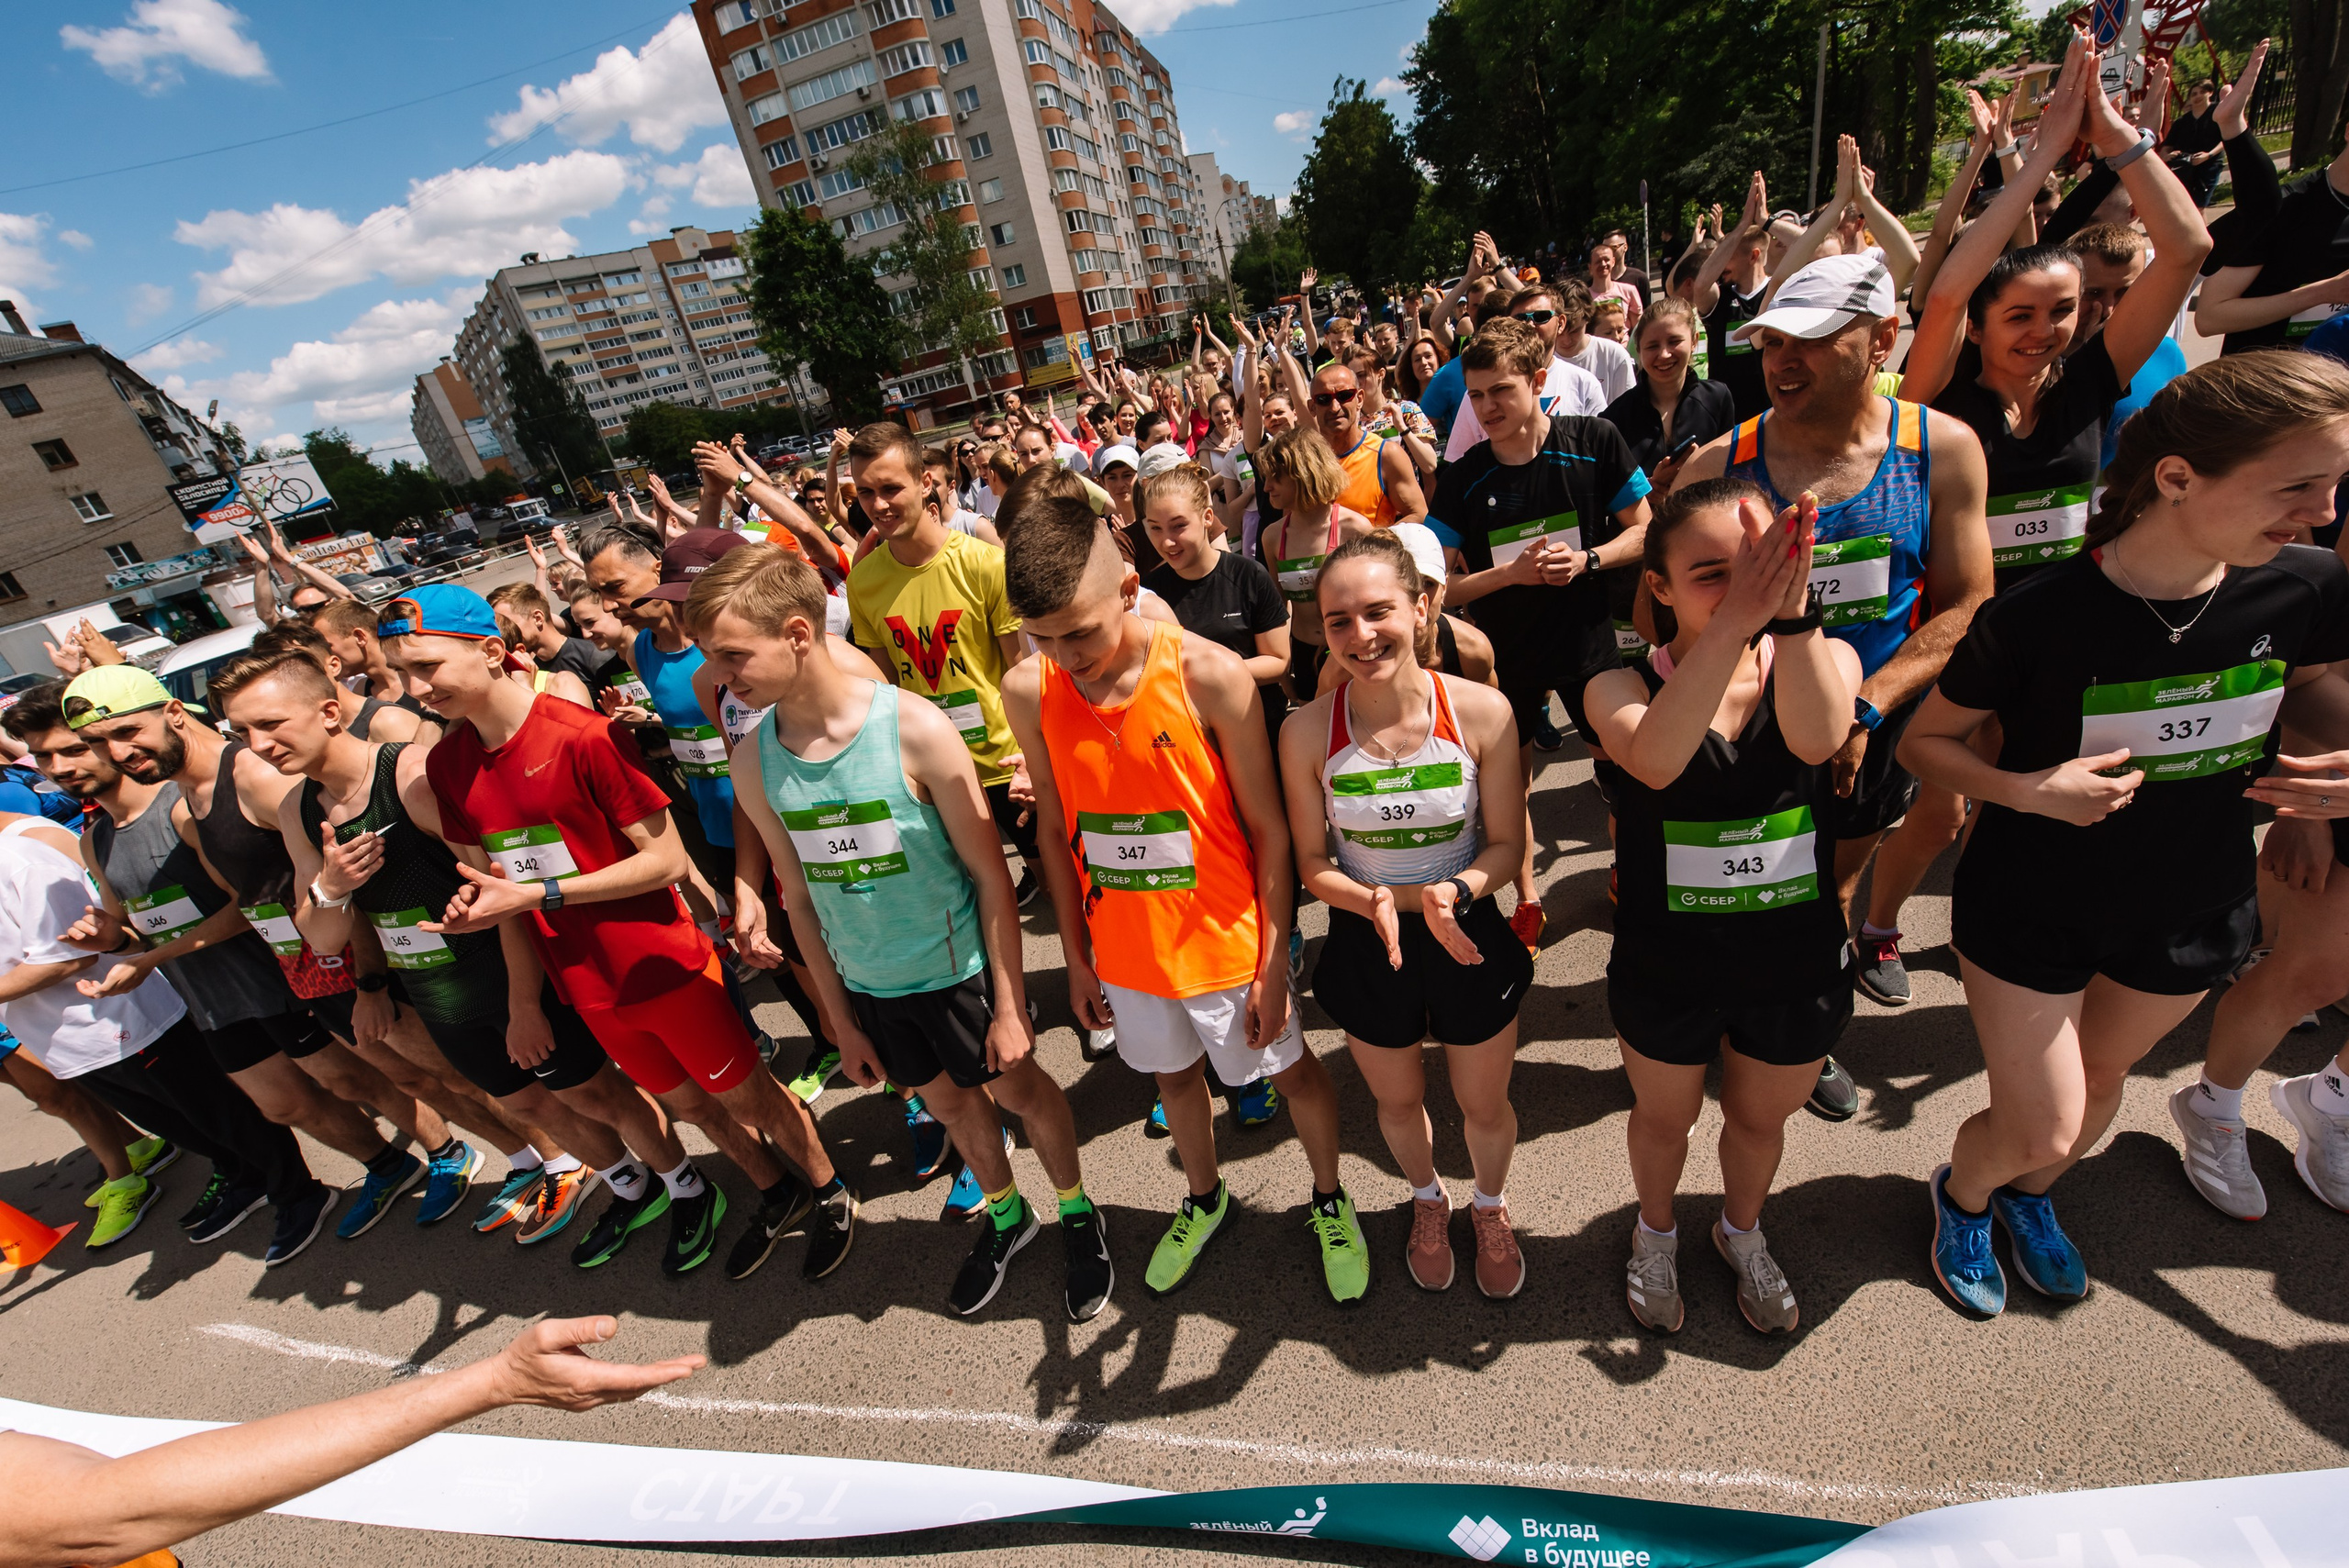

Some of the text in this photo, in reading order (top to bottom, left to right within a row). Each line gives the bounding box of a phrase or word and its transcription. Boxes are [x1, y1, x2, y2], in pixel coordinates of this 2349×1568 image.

[174, 477, 229, 495] СКОРОСТНОЙ
[2014, 520, 2048, 537] 033
[1993, 552, 2023, 562] СБЕР
[892, 624, 958, 649] ONE
[901, 656, 967, 682] RUN
[2157, 685, 2194, 695] ЗЕЛЁНЫЙ
[2154, 695, 2195, 704] МАРАФОН
[2157, 717, 2211, 742] 337
[689, 749, 706, 759] 028
[1380, 804, 1415, 821] 339
[828, 838, 858, 854] 344
[1118, 846, 1146, 860] 347
[515, 858, 540, 873] 342
[1722, 856, 1765, 876] 343
[1108, 874, 1130, 884] СБЕР
[1699, 895, 1736, 906] СБЕР
[148, 916, 167, 928] 346
[390, 936, 411, 947] 345
[1189, 1520, 1275, 1531] ЗЕЛЁНЫЙ
[1521, 1518, 1599, 1542] Вклад
[1524, 1541, 1652, 1568] в будущее
